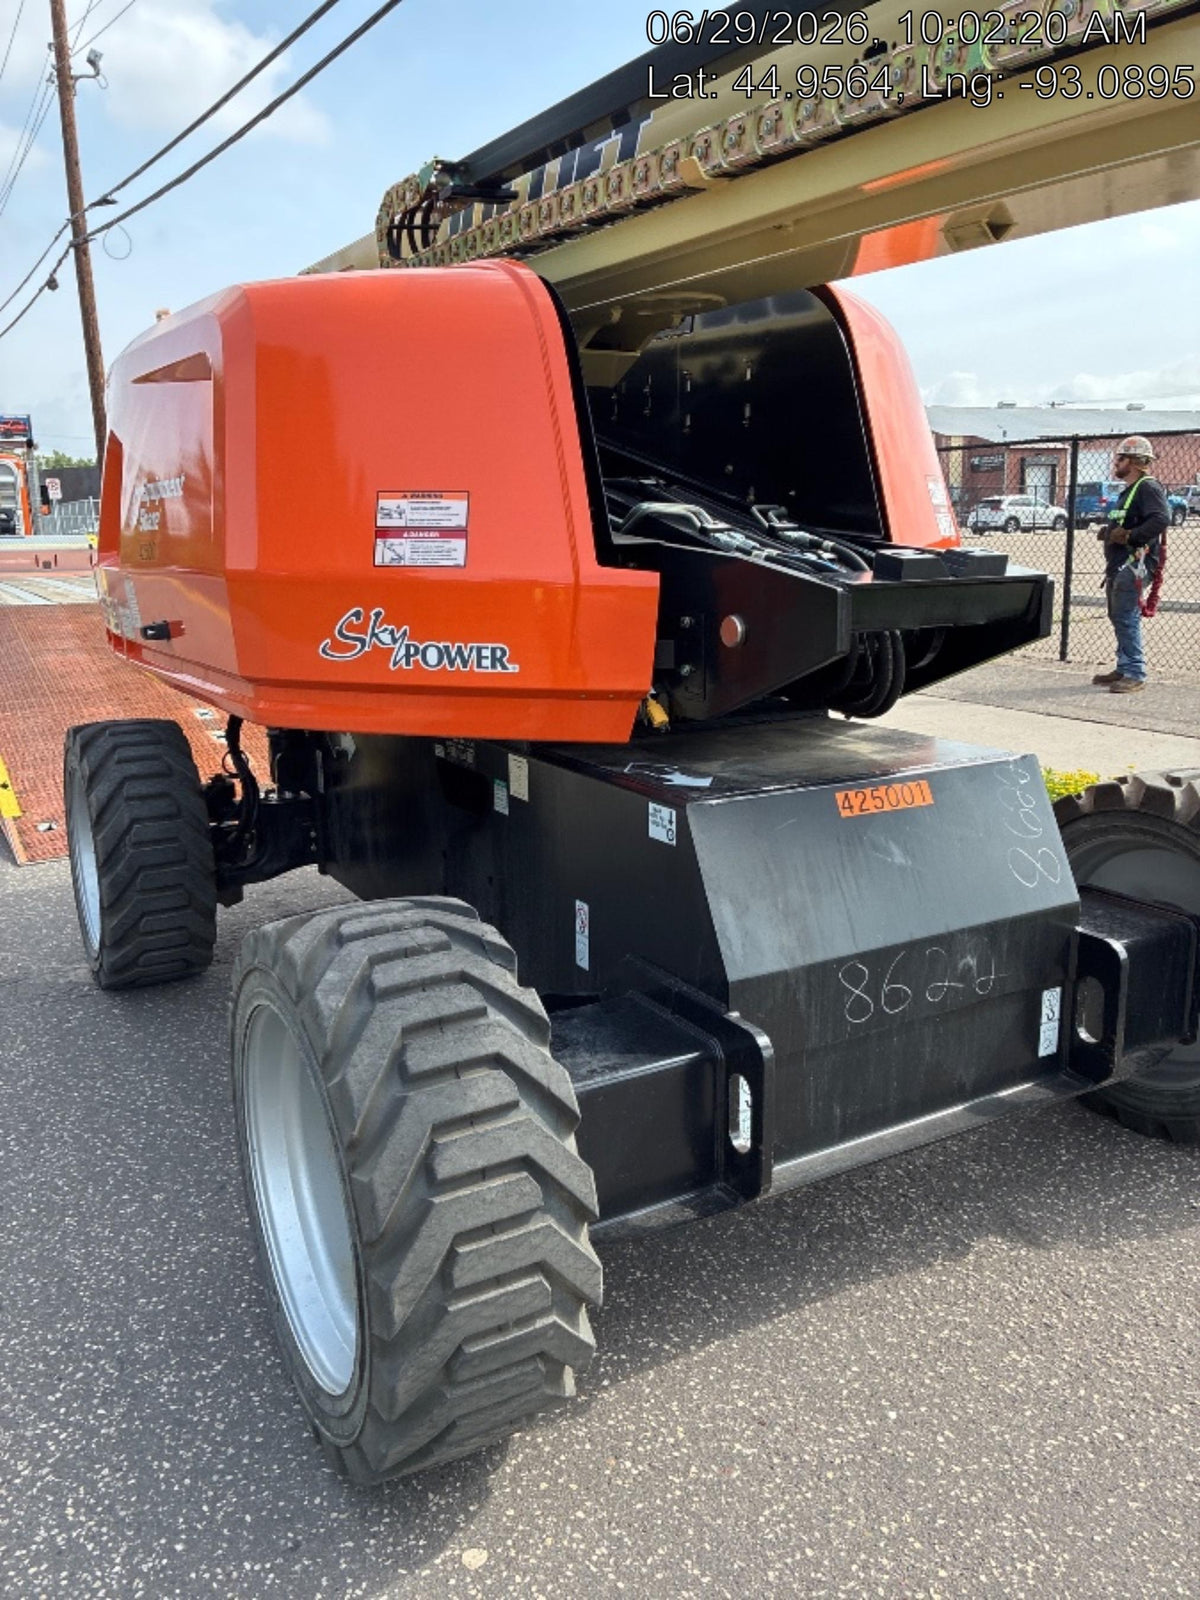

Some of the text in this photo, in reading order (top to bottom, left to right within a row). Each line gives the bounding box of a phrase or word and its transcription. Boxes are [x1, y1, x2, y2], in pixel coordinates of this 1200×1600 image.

[319, 607, 511, 672] Sky POWER
[840, 781, 928, 815] 425001
